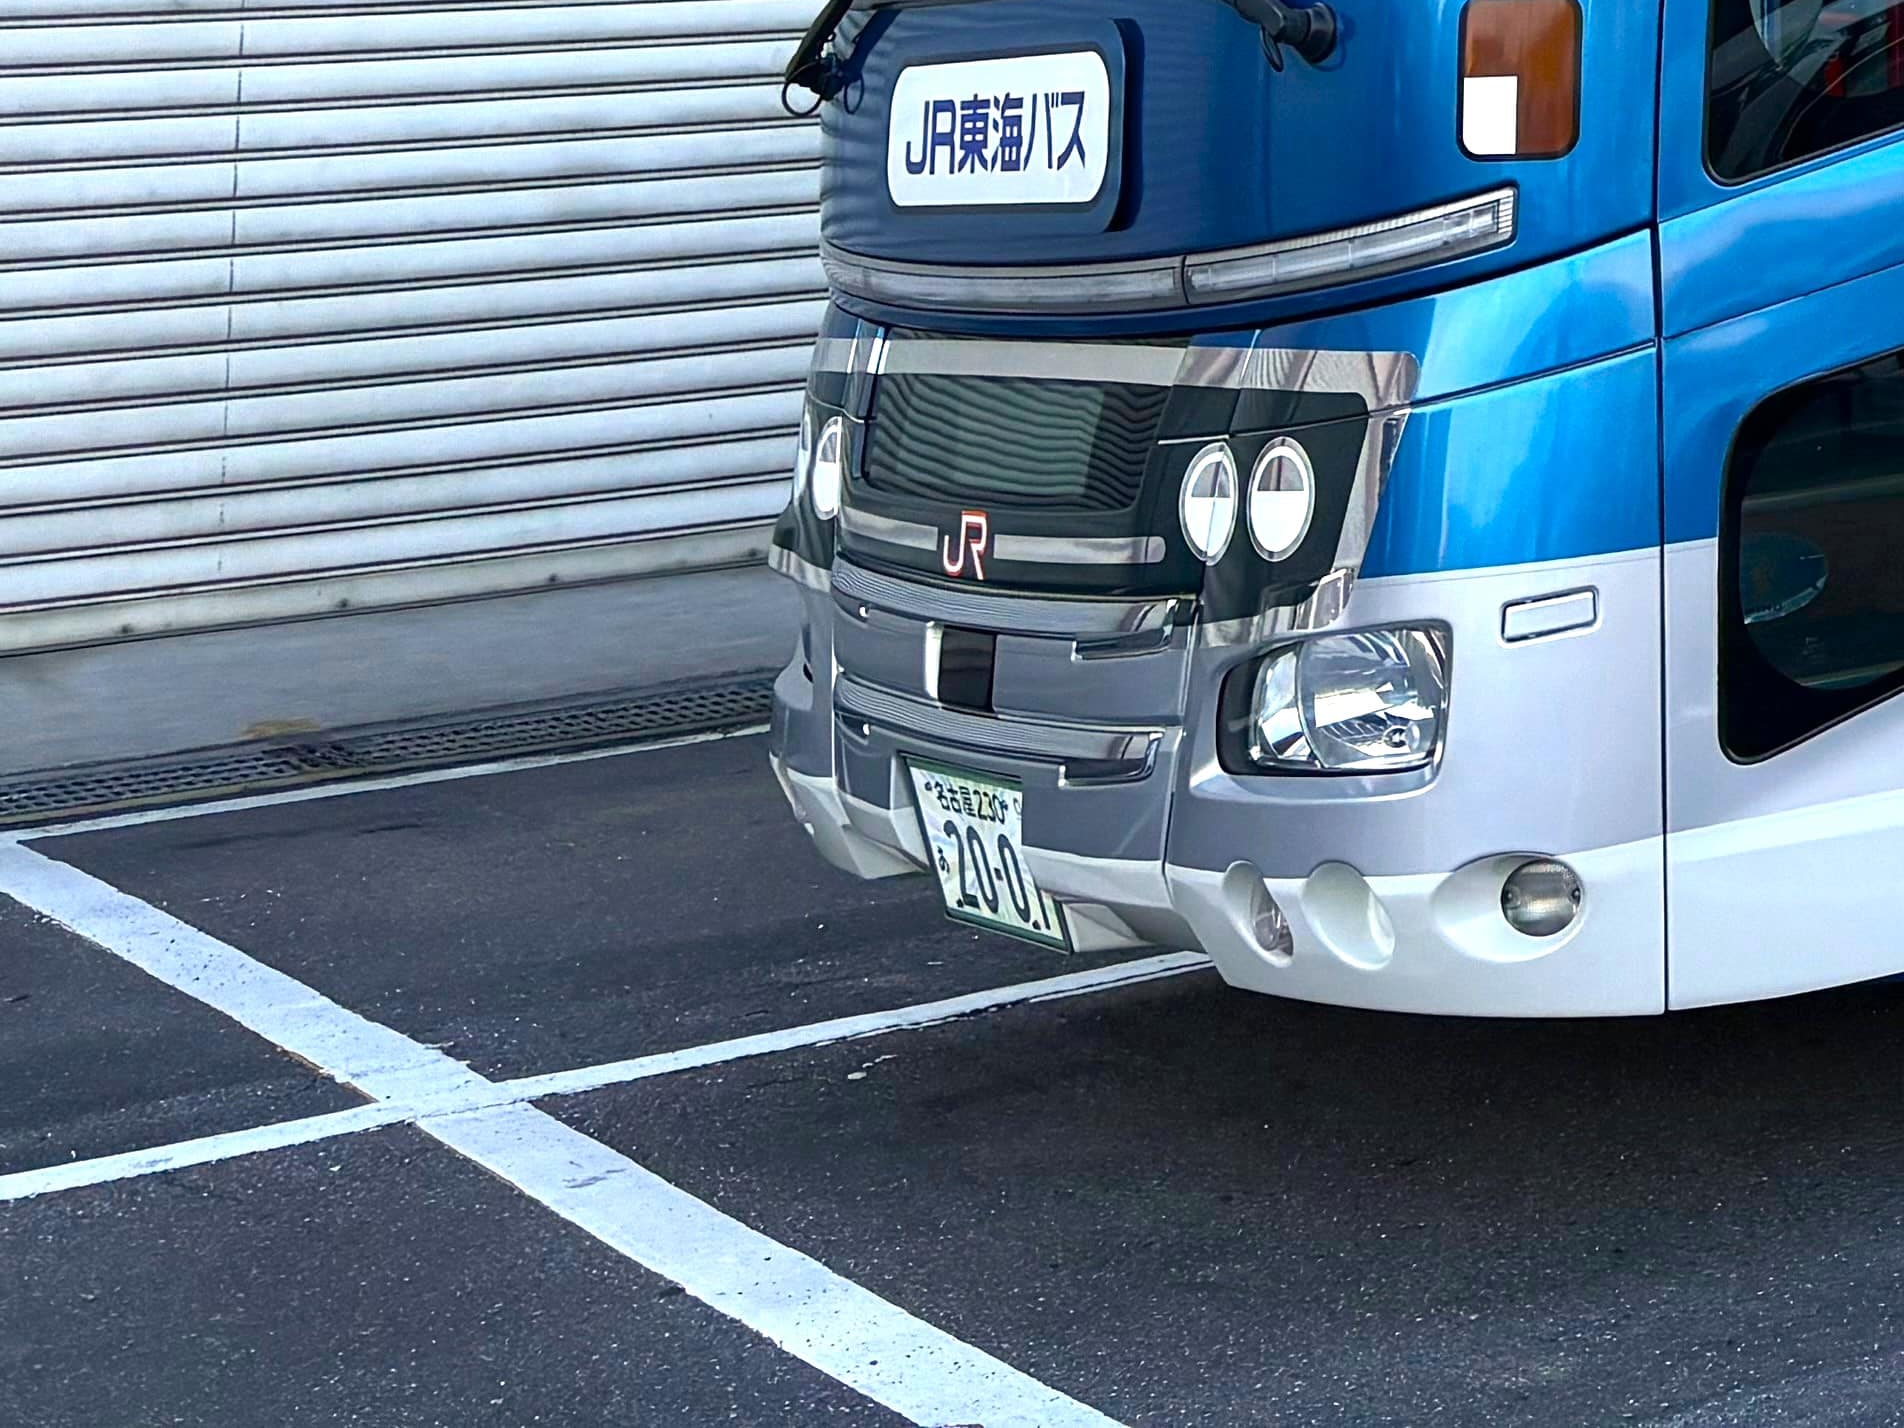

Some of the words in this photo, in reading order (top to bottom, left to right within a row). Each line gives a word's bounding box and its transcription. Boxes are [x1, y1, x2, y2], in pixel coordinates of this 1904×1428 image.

[905, 90, 1086, 176] JR東海バス
[943, 510, 988, 580] JR
